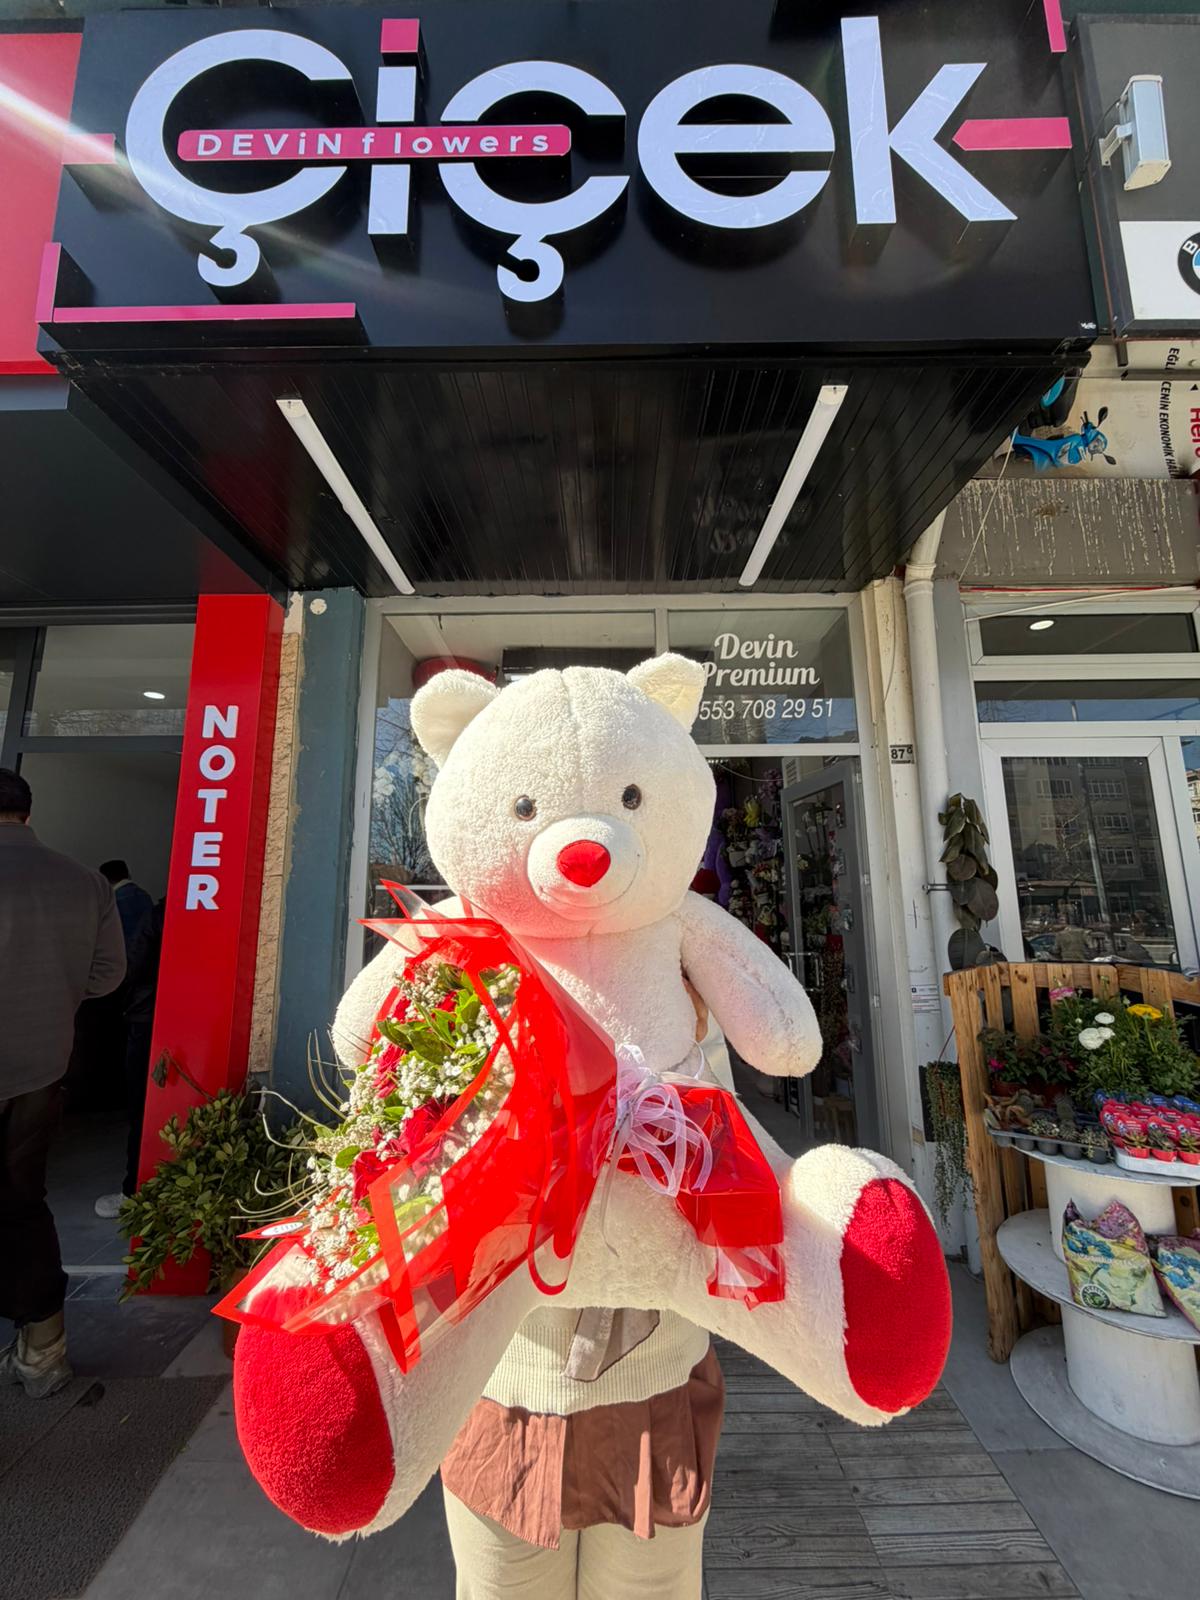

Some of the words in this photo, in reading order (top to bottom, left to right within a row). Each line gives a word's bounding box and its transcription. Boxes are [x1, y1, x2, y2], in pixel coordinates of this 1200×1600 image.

[125, 15, 1018, 303] Çiçek
[714, 632, 798, 660] Devin
[700, 661, 820, 687] Premium
[699, 700, 735, 720] 553
[742, 699, 777, 719] 708
[781, 699, 806, 718] 29
[811, 697, 833, 718] 51
[185, 705, 239, 910] NOTER
